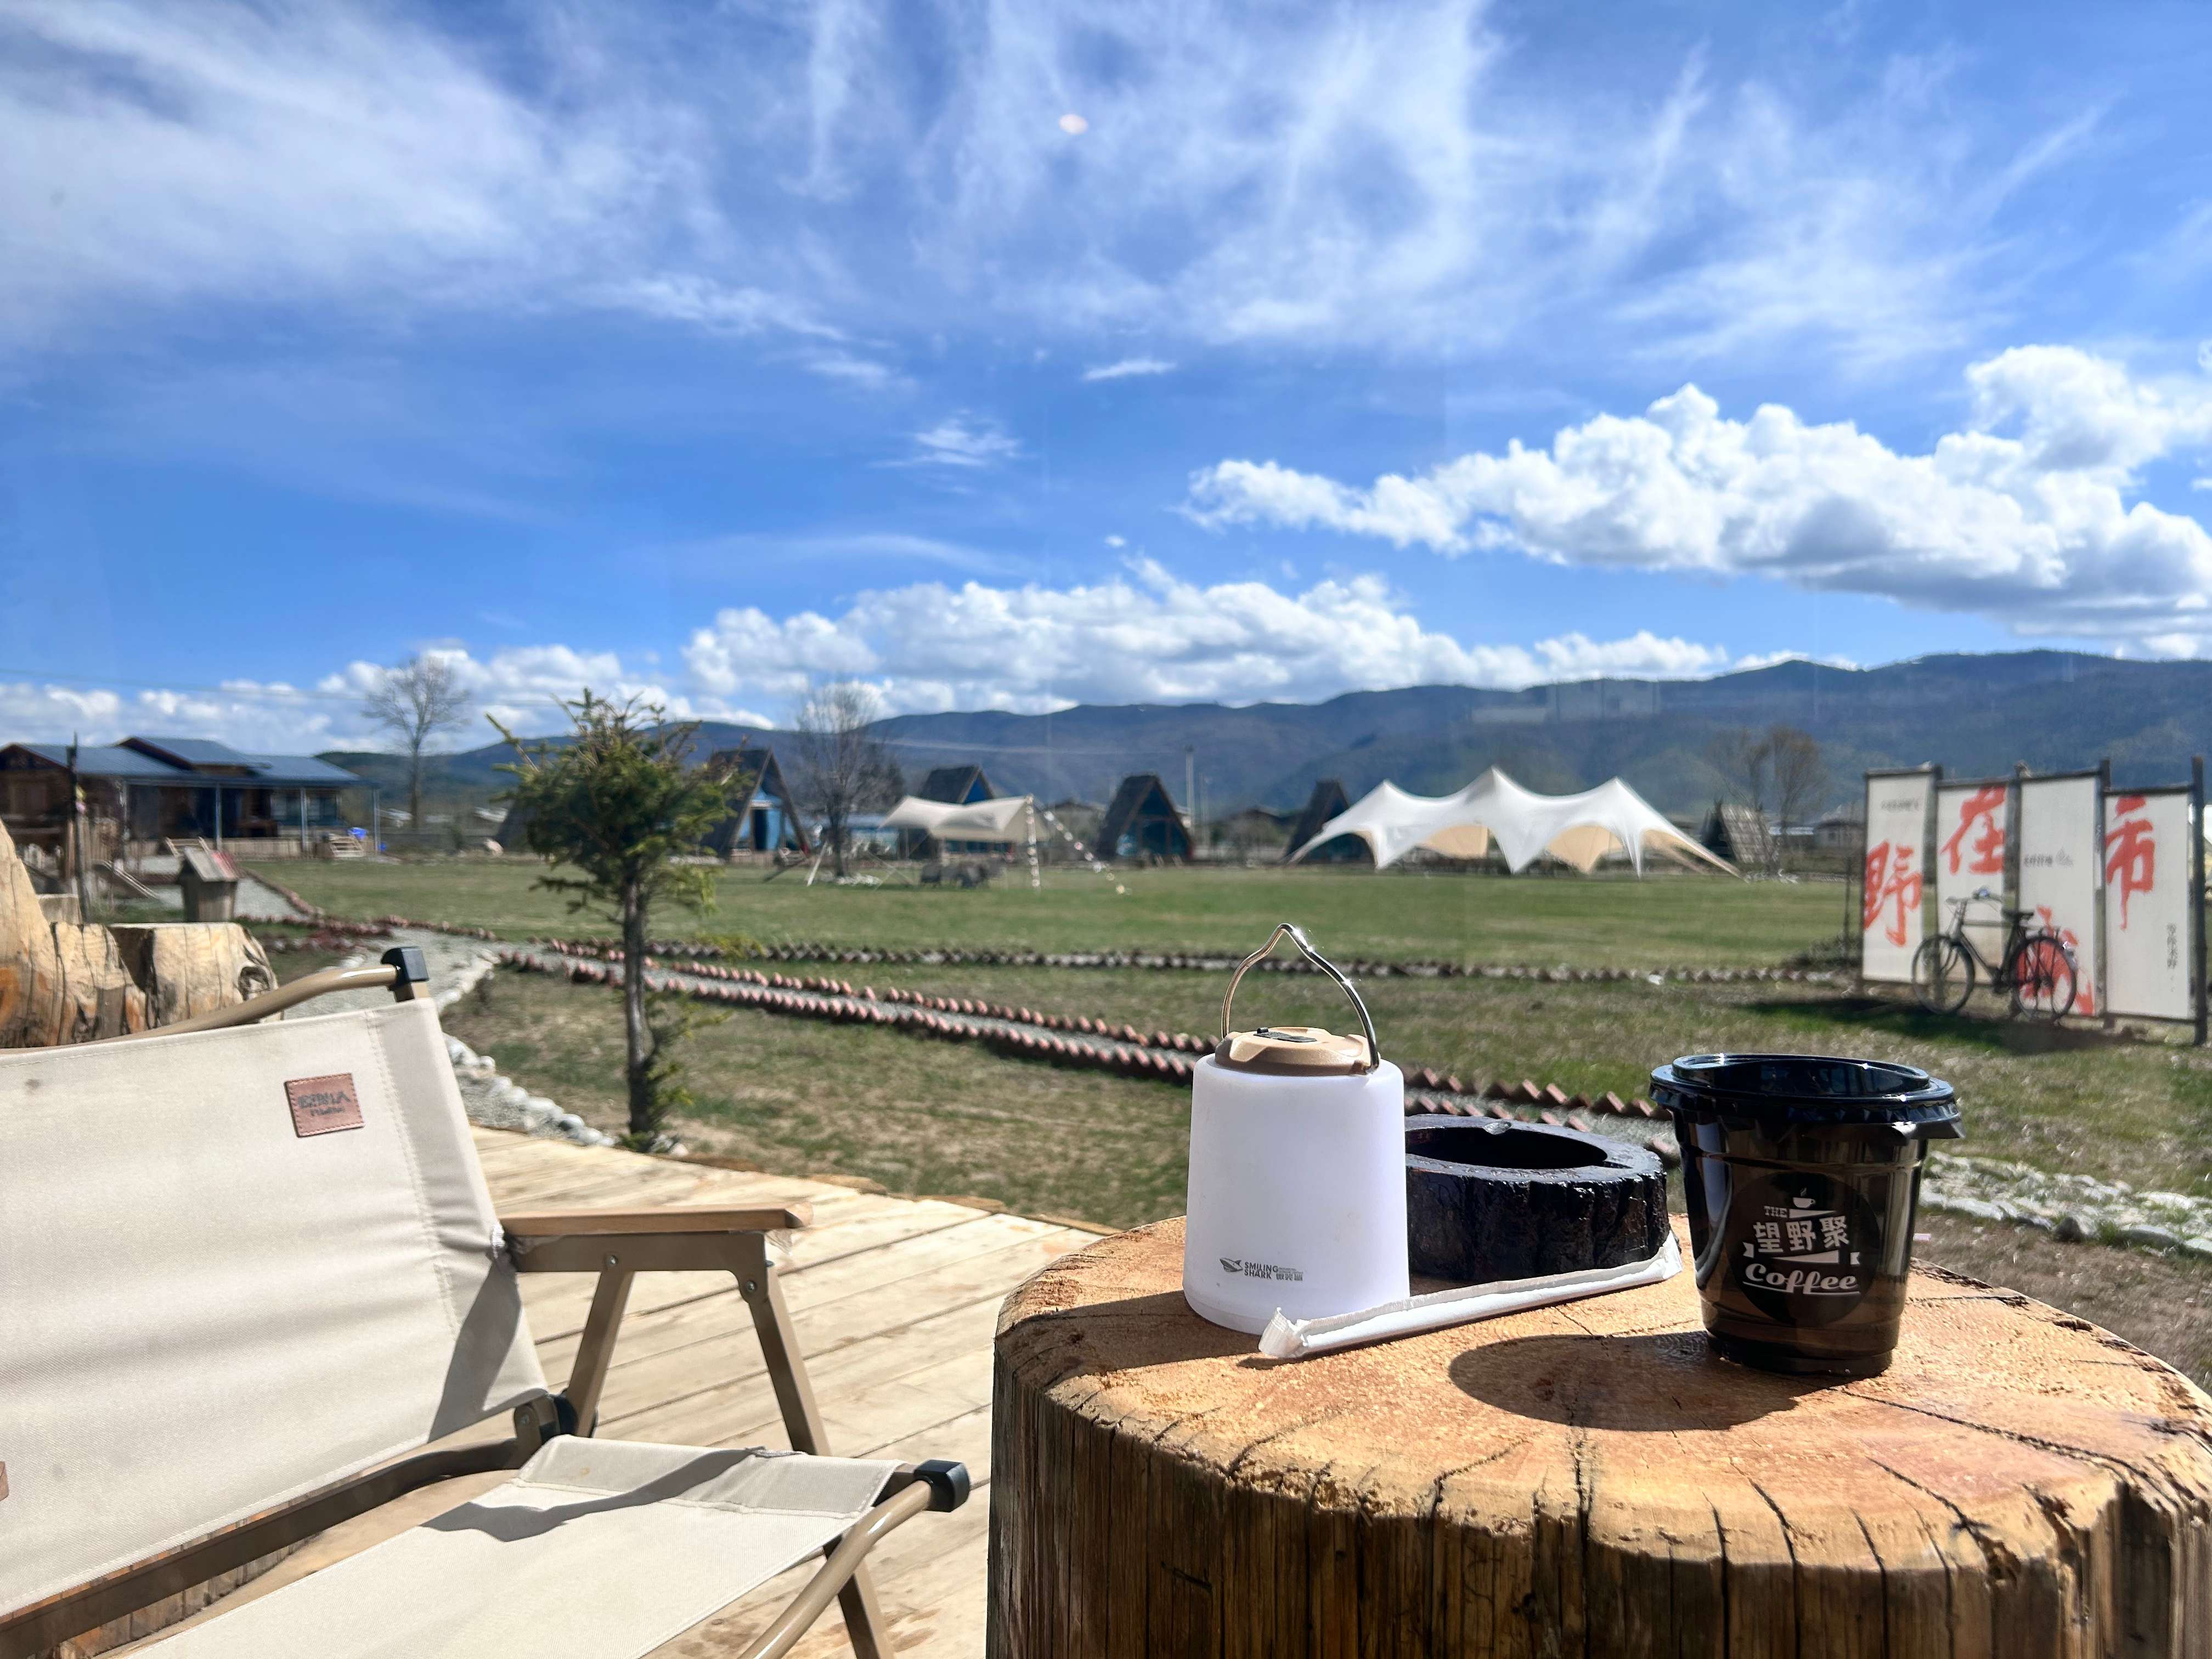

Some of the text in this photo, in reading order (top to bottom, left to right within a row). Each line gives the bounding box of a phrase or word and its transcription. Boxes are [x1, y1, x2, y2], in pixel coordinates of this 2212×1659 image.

[1939, 785, 2006, 875] 在
[2105, 794, 2155, 930] 市
[1865, 839, 1922, 947] 野
[1764, 1206, 1788, 1218] THE
[1753, 1215, 1850, 1253] 望野聚
[1244, 1261, 1279, 1273] SMILING
[1244, 1268, 1272, 1279] SHARK
[1743, 1263, 1860, 1295] Coffee
